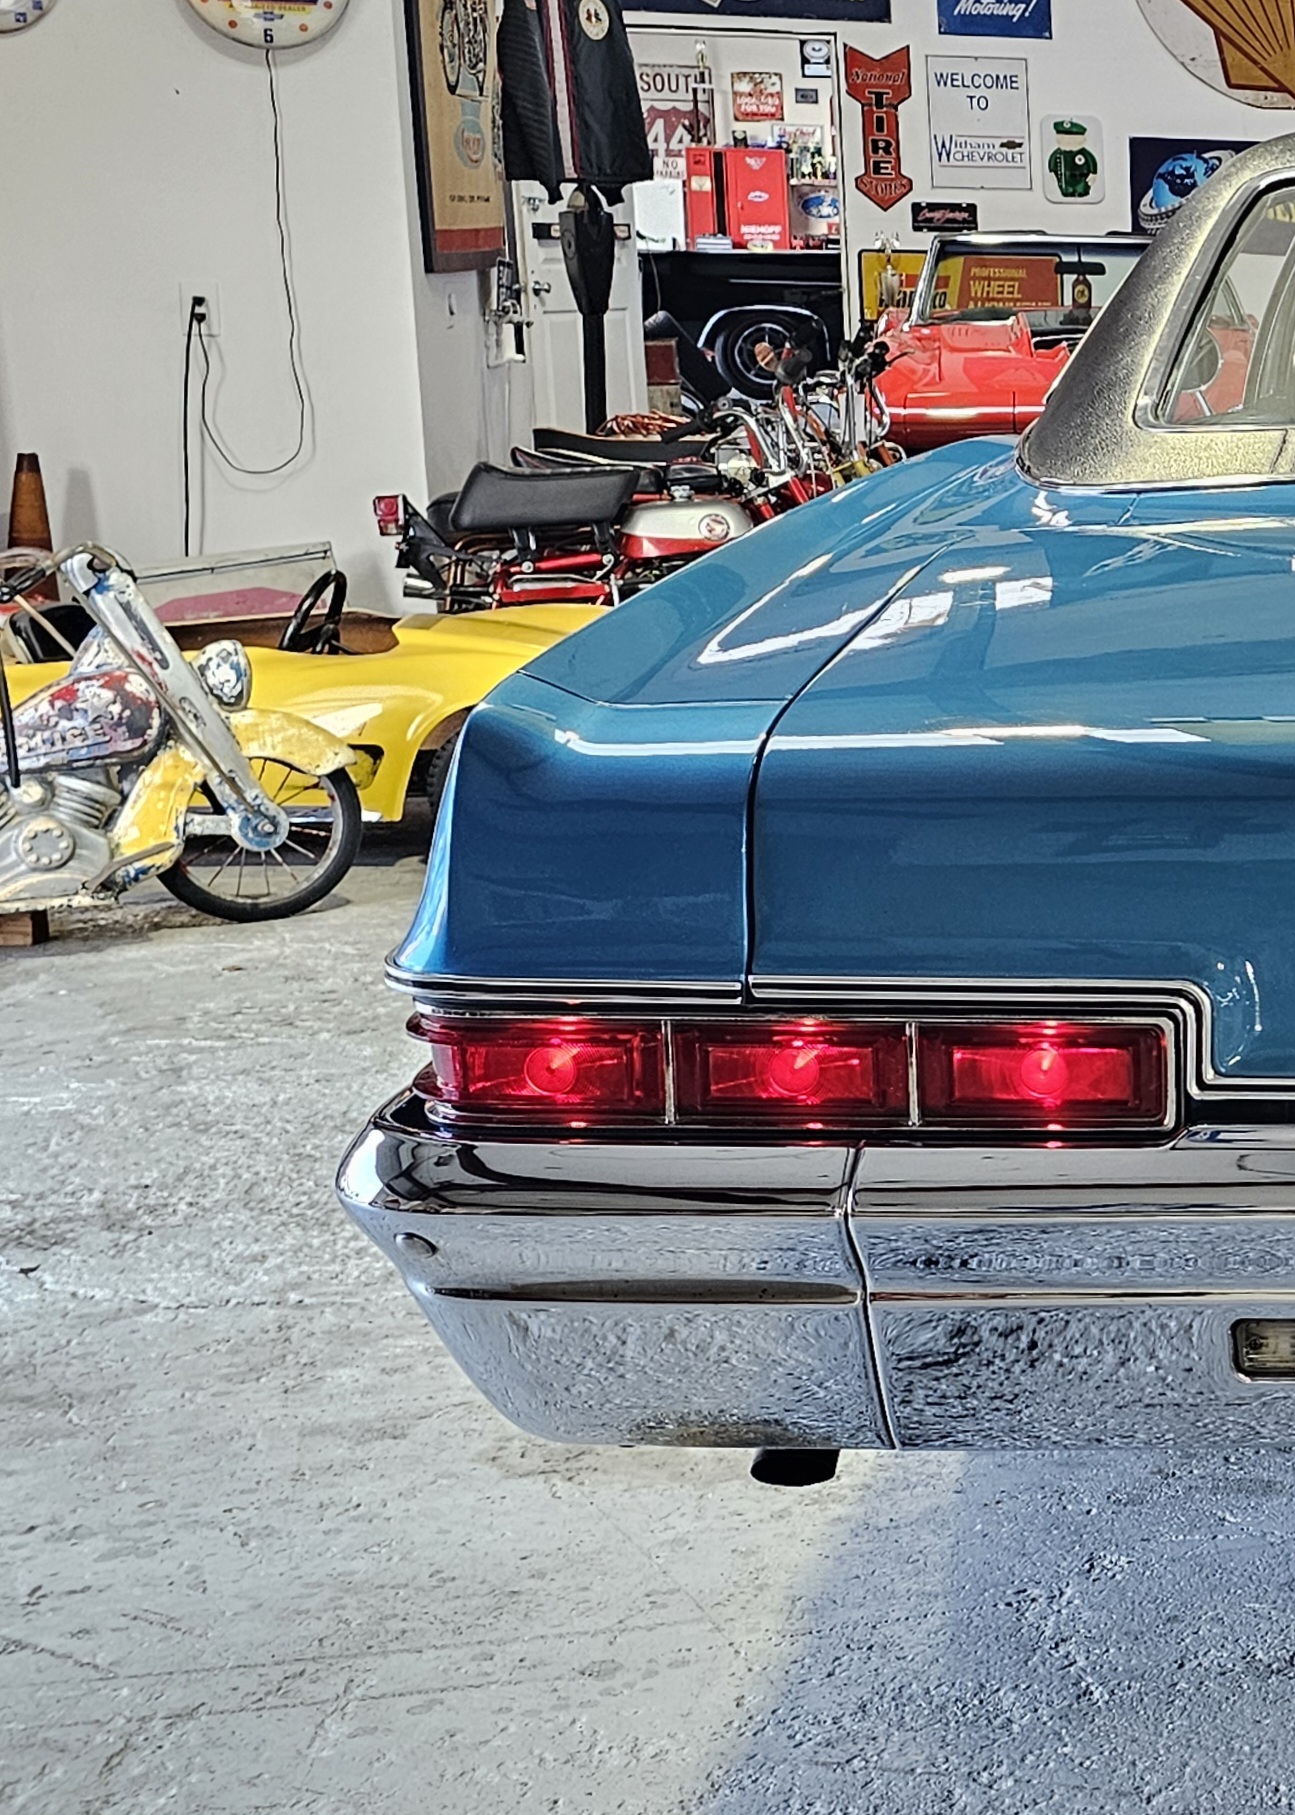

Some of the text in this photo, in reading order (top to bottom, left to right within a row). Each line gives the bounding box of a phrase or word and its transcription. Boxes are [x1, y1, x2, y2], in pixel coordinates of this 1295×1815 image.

[953, 0, 1038, 22] Motoring!
[263, 28, 274, 44] 6
[851, 68, 906, 86] National
[934, 72, 1020, 90] WELCOME
[966, 95, 989, 111] TO
[647, 117, 694, 158] 44
[867, 89, 895, 178] TIRE
[934, 134, 996, 163] Witham
[953, 151, 1025, 164] CHEVROLET
[662, 160, 679, 170] NO
[860, 177, 908, 199] STORES
[970, 266, 1027, 278] PROFESSIONAL
[969, 280, 1022, 298] WHEEL
